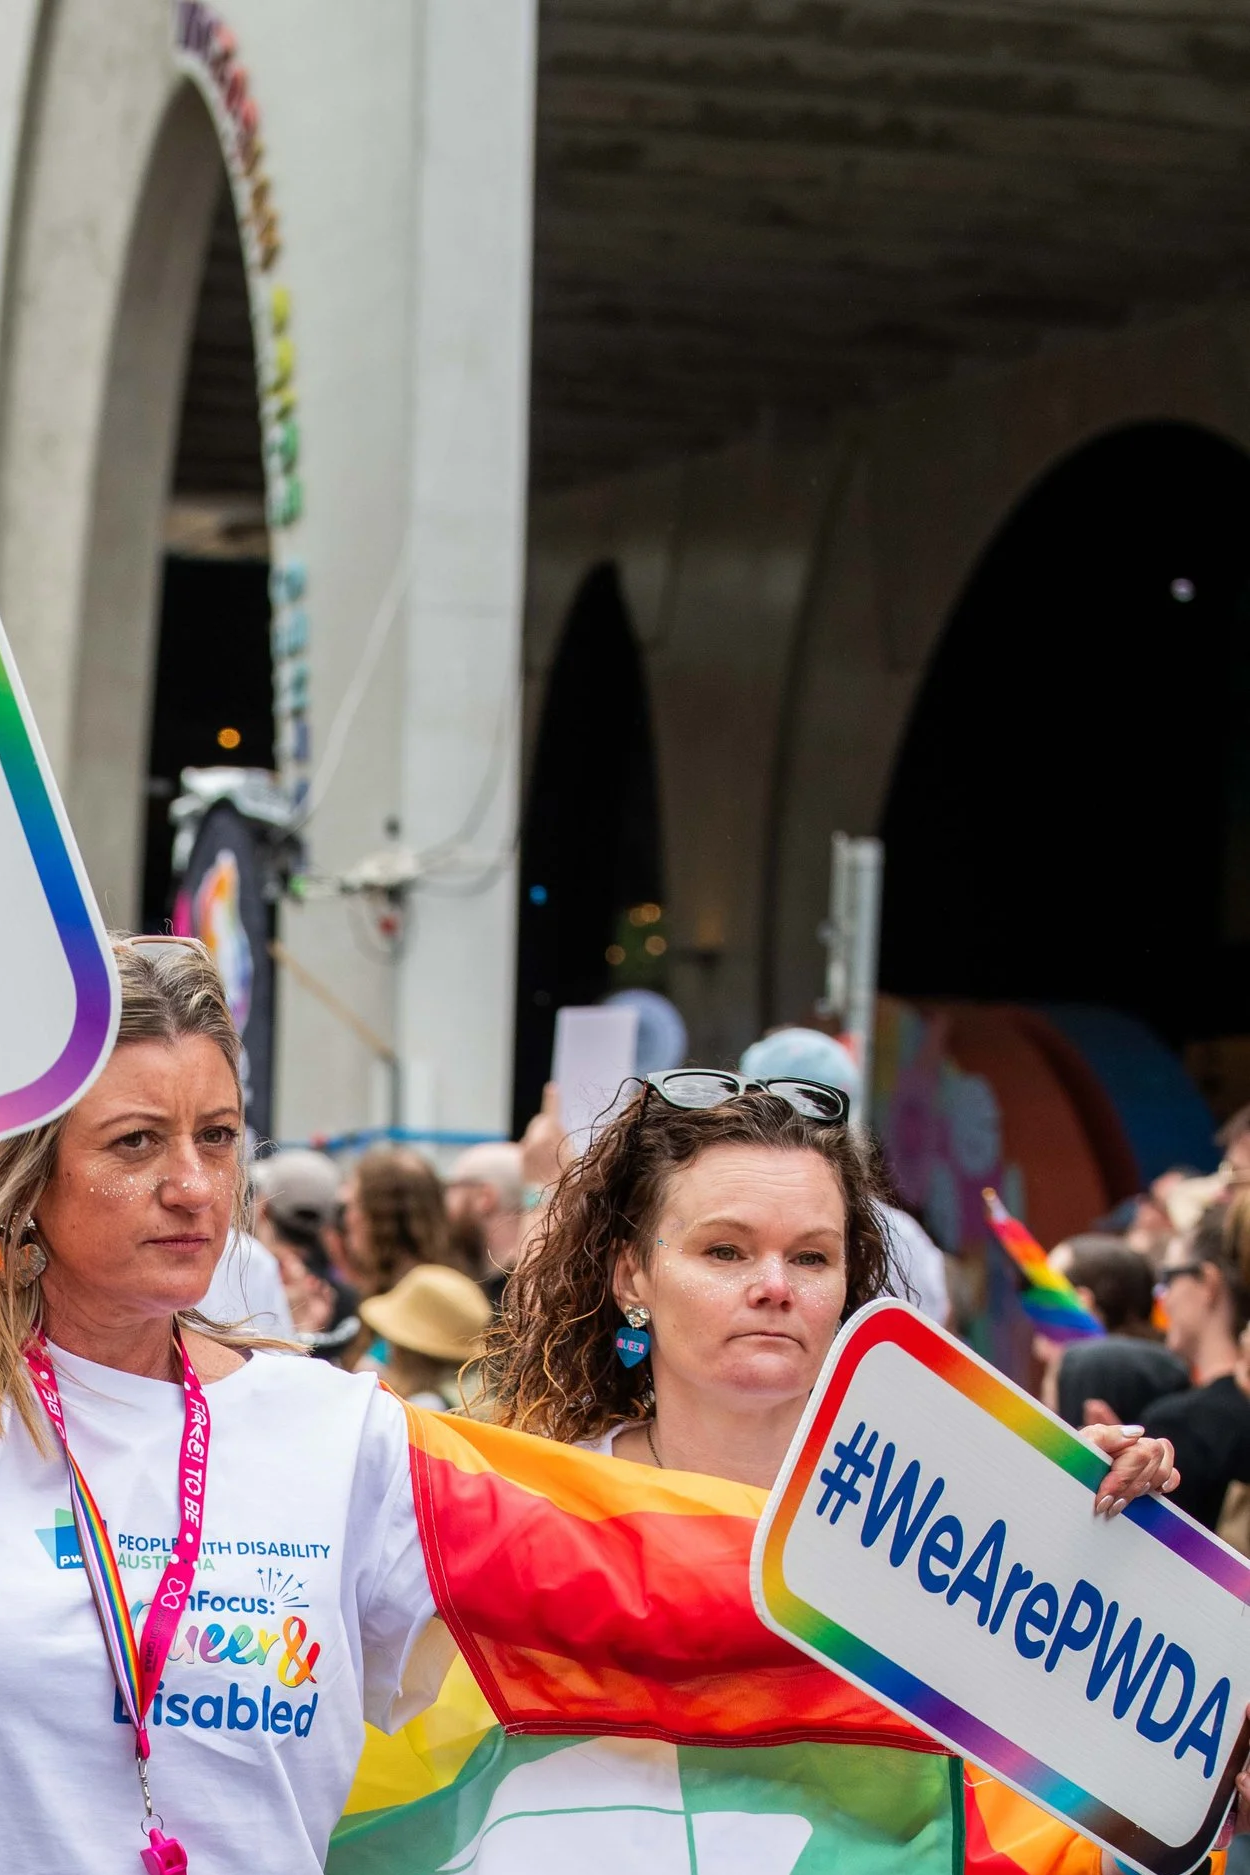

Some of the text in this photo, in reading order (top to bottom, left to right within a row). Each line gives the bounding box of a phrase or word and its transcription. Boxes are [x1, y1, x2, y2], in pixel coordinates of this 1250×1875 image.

[616, 1337, 645, 1355] QUEER
[184, 1468, 203, 1496] TO
[184, 1497, 200, 1529] BE
[117, 1552, 216, 1572] AUSTIA
[198, 1542, 231, 1555] ITH
[237, 1541, 330, 1559] DISABILITY
[184, 1590, 276, 1615] nFocus:
[816, 1421, 1231, 1779] #WeArePWDA
[131, 1600, 280, 1666] ueer
[277, 1615, 321, 1689] &
